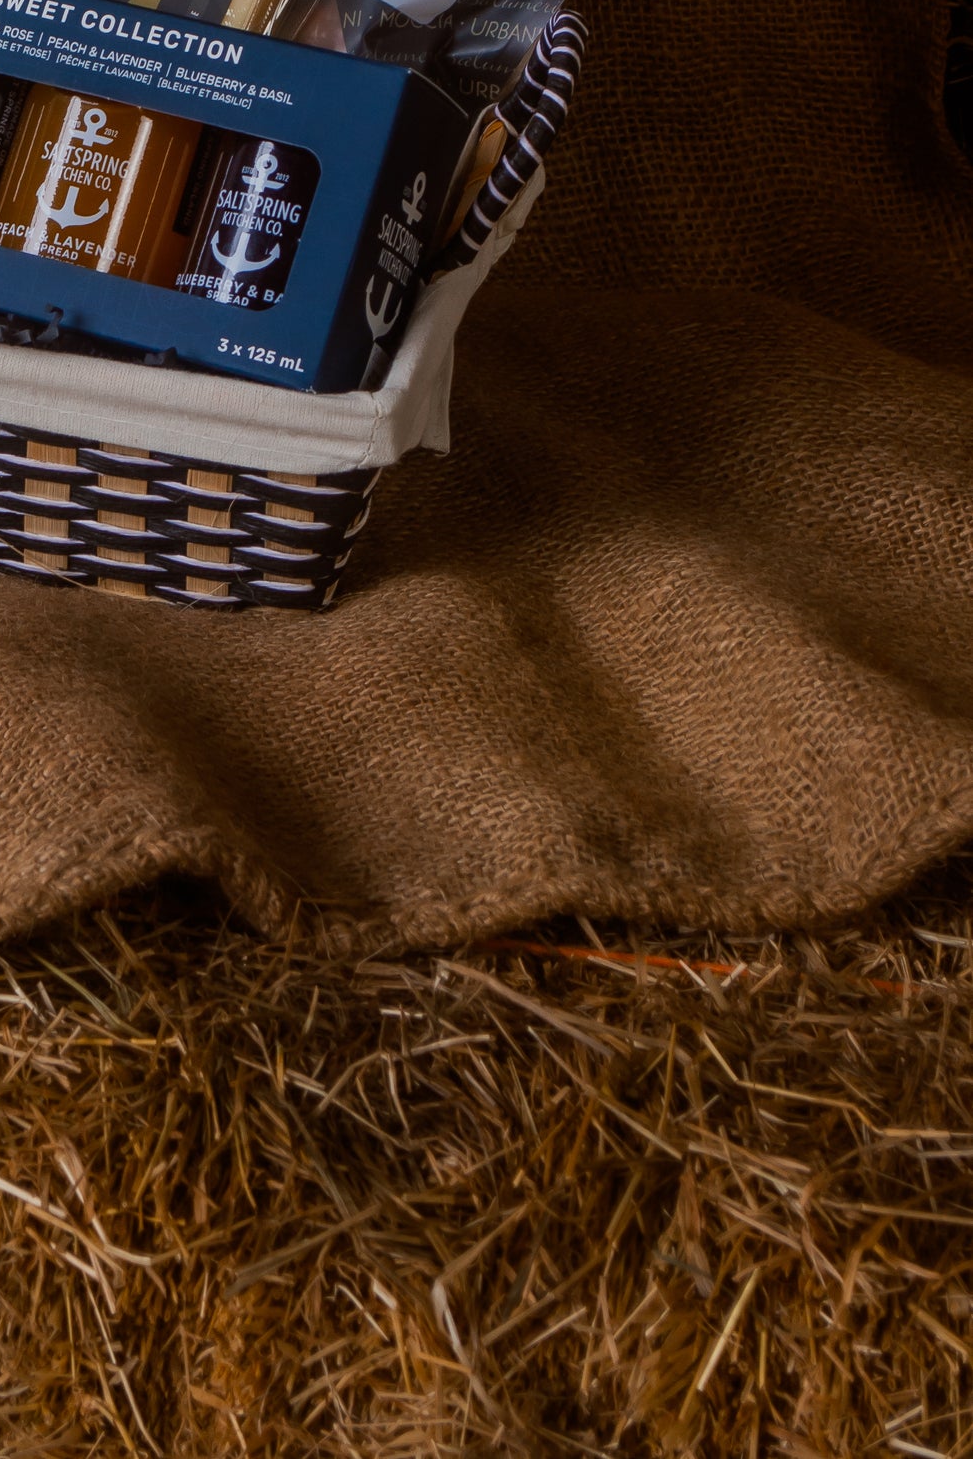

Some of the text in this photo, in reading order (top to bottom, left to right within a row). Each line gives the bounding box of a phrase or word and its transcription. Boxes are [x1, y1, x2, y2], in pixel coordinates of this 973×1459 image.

[80, 10, 244, 65] COLLECTION
[2, 25, 35, 43] ROSE
[47, 36, 88, 55] PEACH
[88, 46, 98, 58] &
[99, 49, 163, 73] LAVENDER
[175, 67, 247, 93] BLUEBERRY
[247, 84, 256, 96] &
[258, 87, 293, 106] BASIL
[9, 43, 23, 53] ET
[23, 45, 51, 61] ROSE]
[92, 62, 105, 73] ET
[105, 65, 153, 86] LAVANDE]
[157, 77, 198, 95] [BLEUET
[198, 88, 211, 98] ET
[212, 91, 252, 110] BASILIC]
[103, 127, 119, 138] 2012
[94, 174, 112, 192] CO.
[275, 173, 290, 183] 2012
[217, 189, 302, 224] SALTSPRING
[221, 211, 283, 237] KITCHEN CO.
[54, 233, 136, 268] LAVENDER
[247, 285, 259, 299] &
[217, 337, 305, 373] 3 x 125 mL
